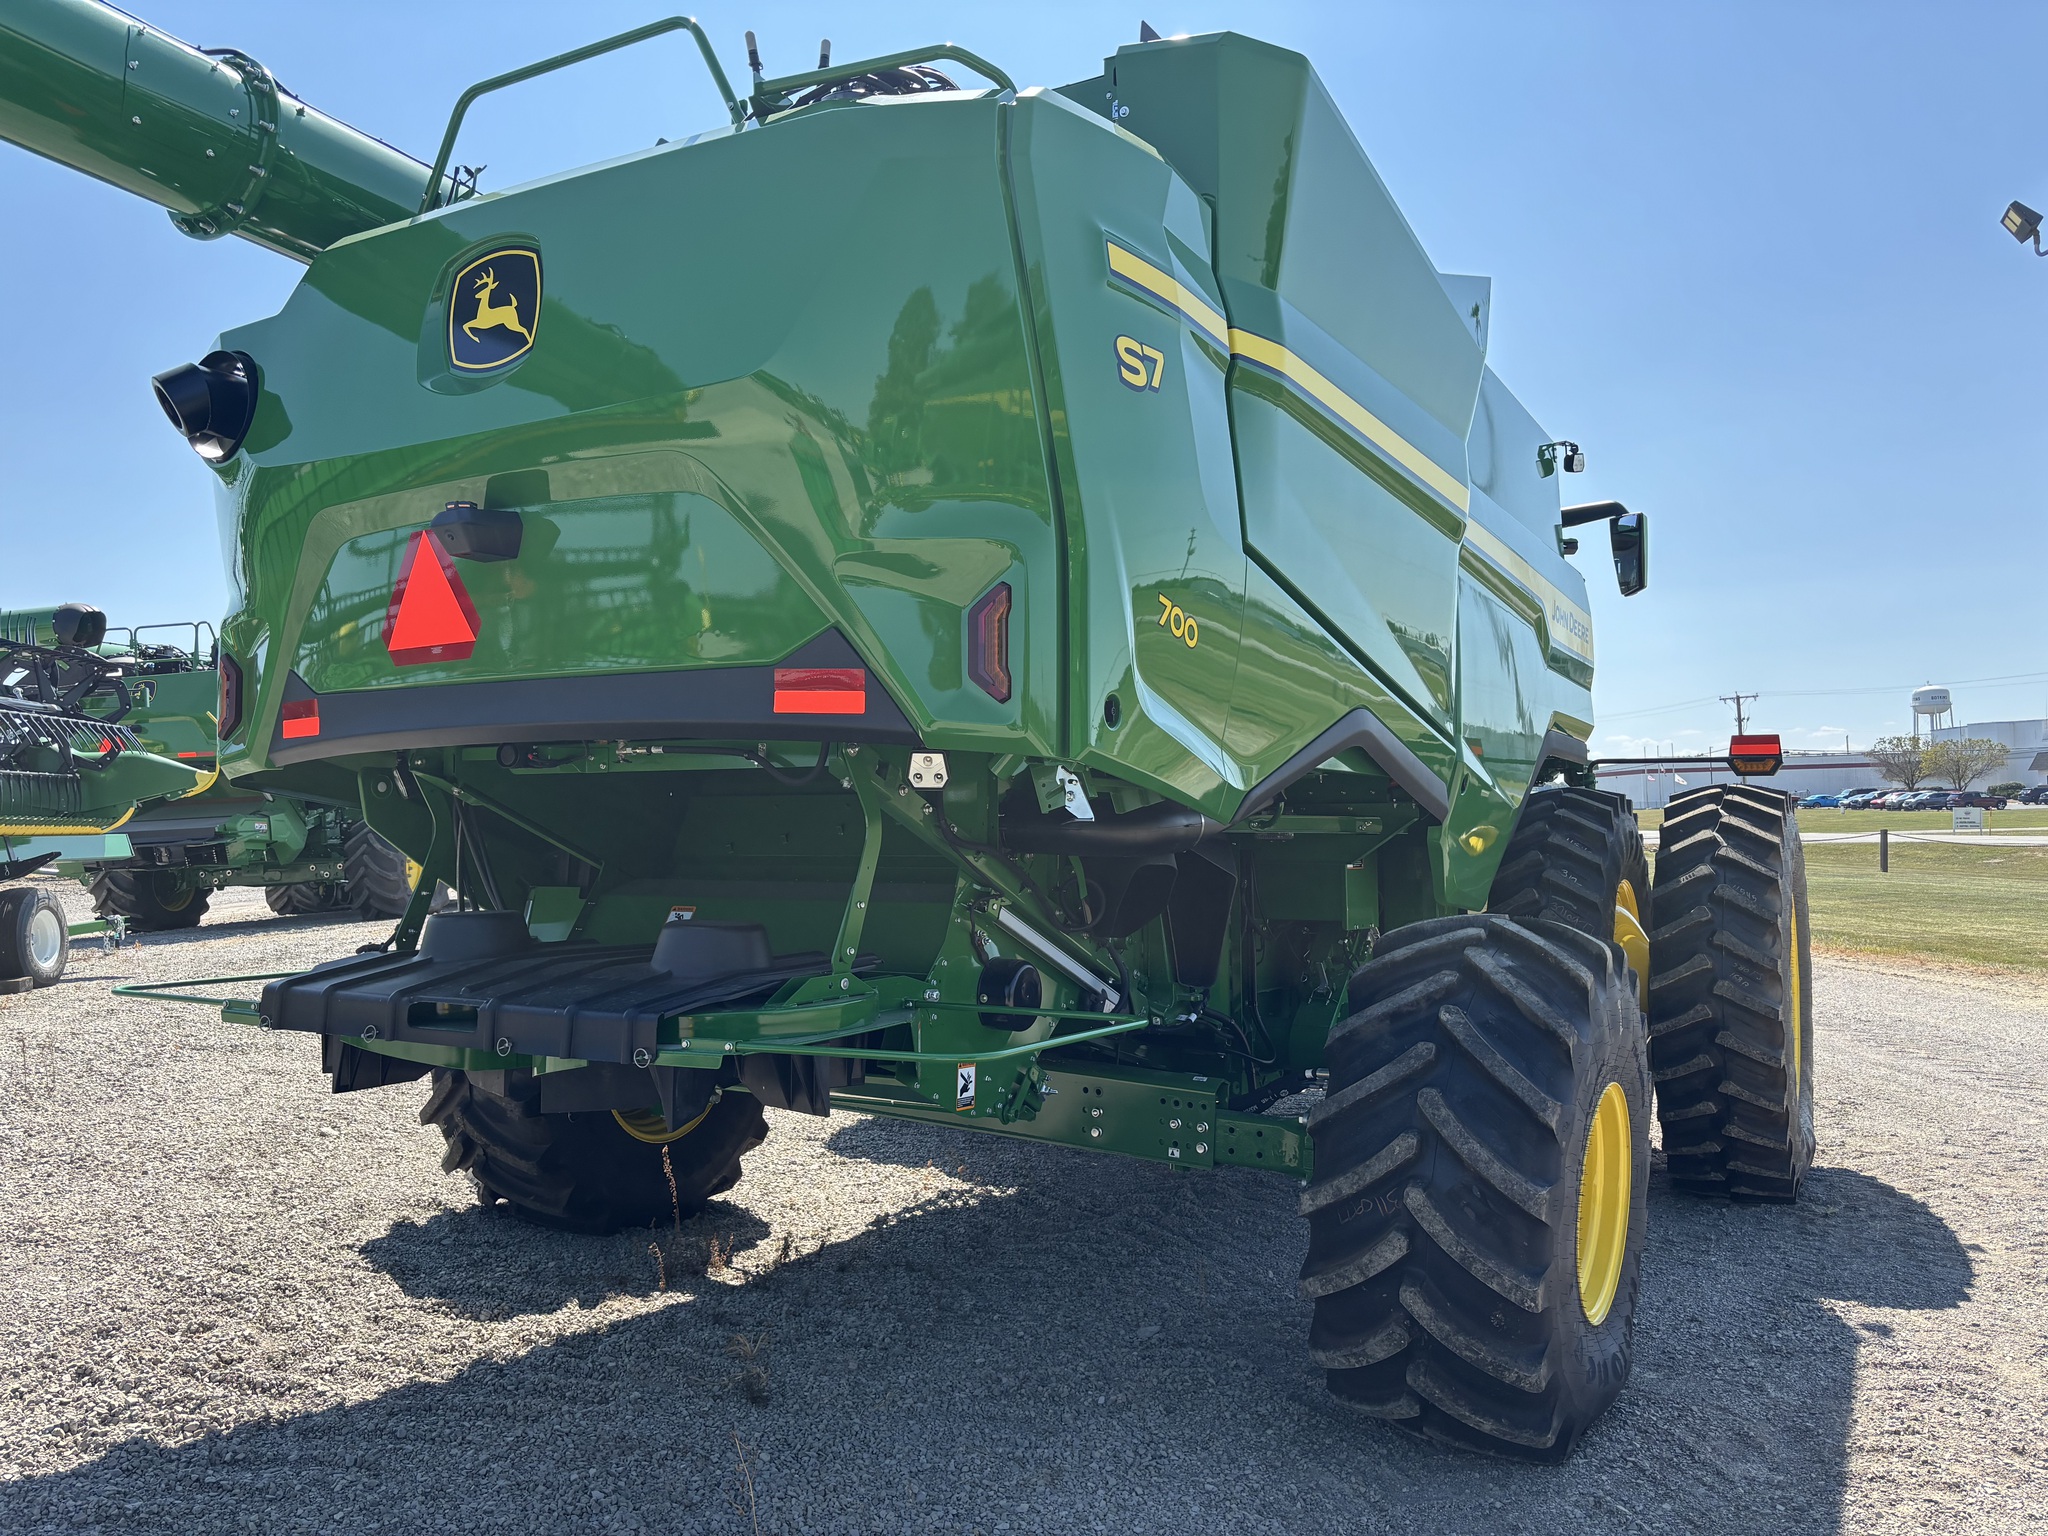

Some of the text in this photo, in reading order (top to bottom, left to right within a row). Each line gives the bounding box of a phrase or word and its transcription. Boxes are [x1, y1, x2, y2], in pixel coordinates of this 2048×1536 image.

[1113, 334, 1165, 393] S7
[1158, 591, 1199, 649] 700
[1551, 600, 1589, 645] JOHN DEERE
